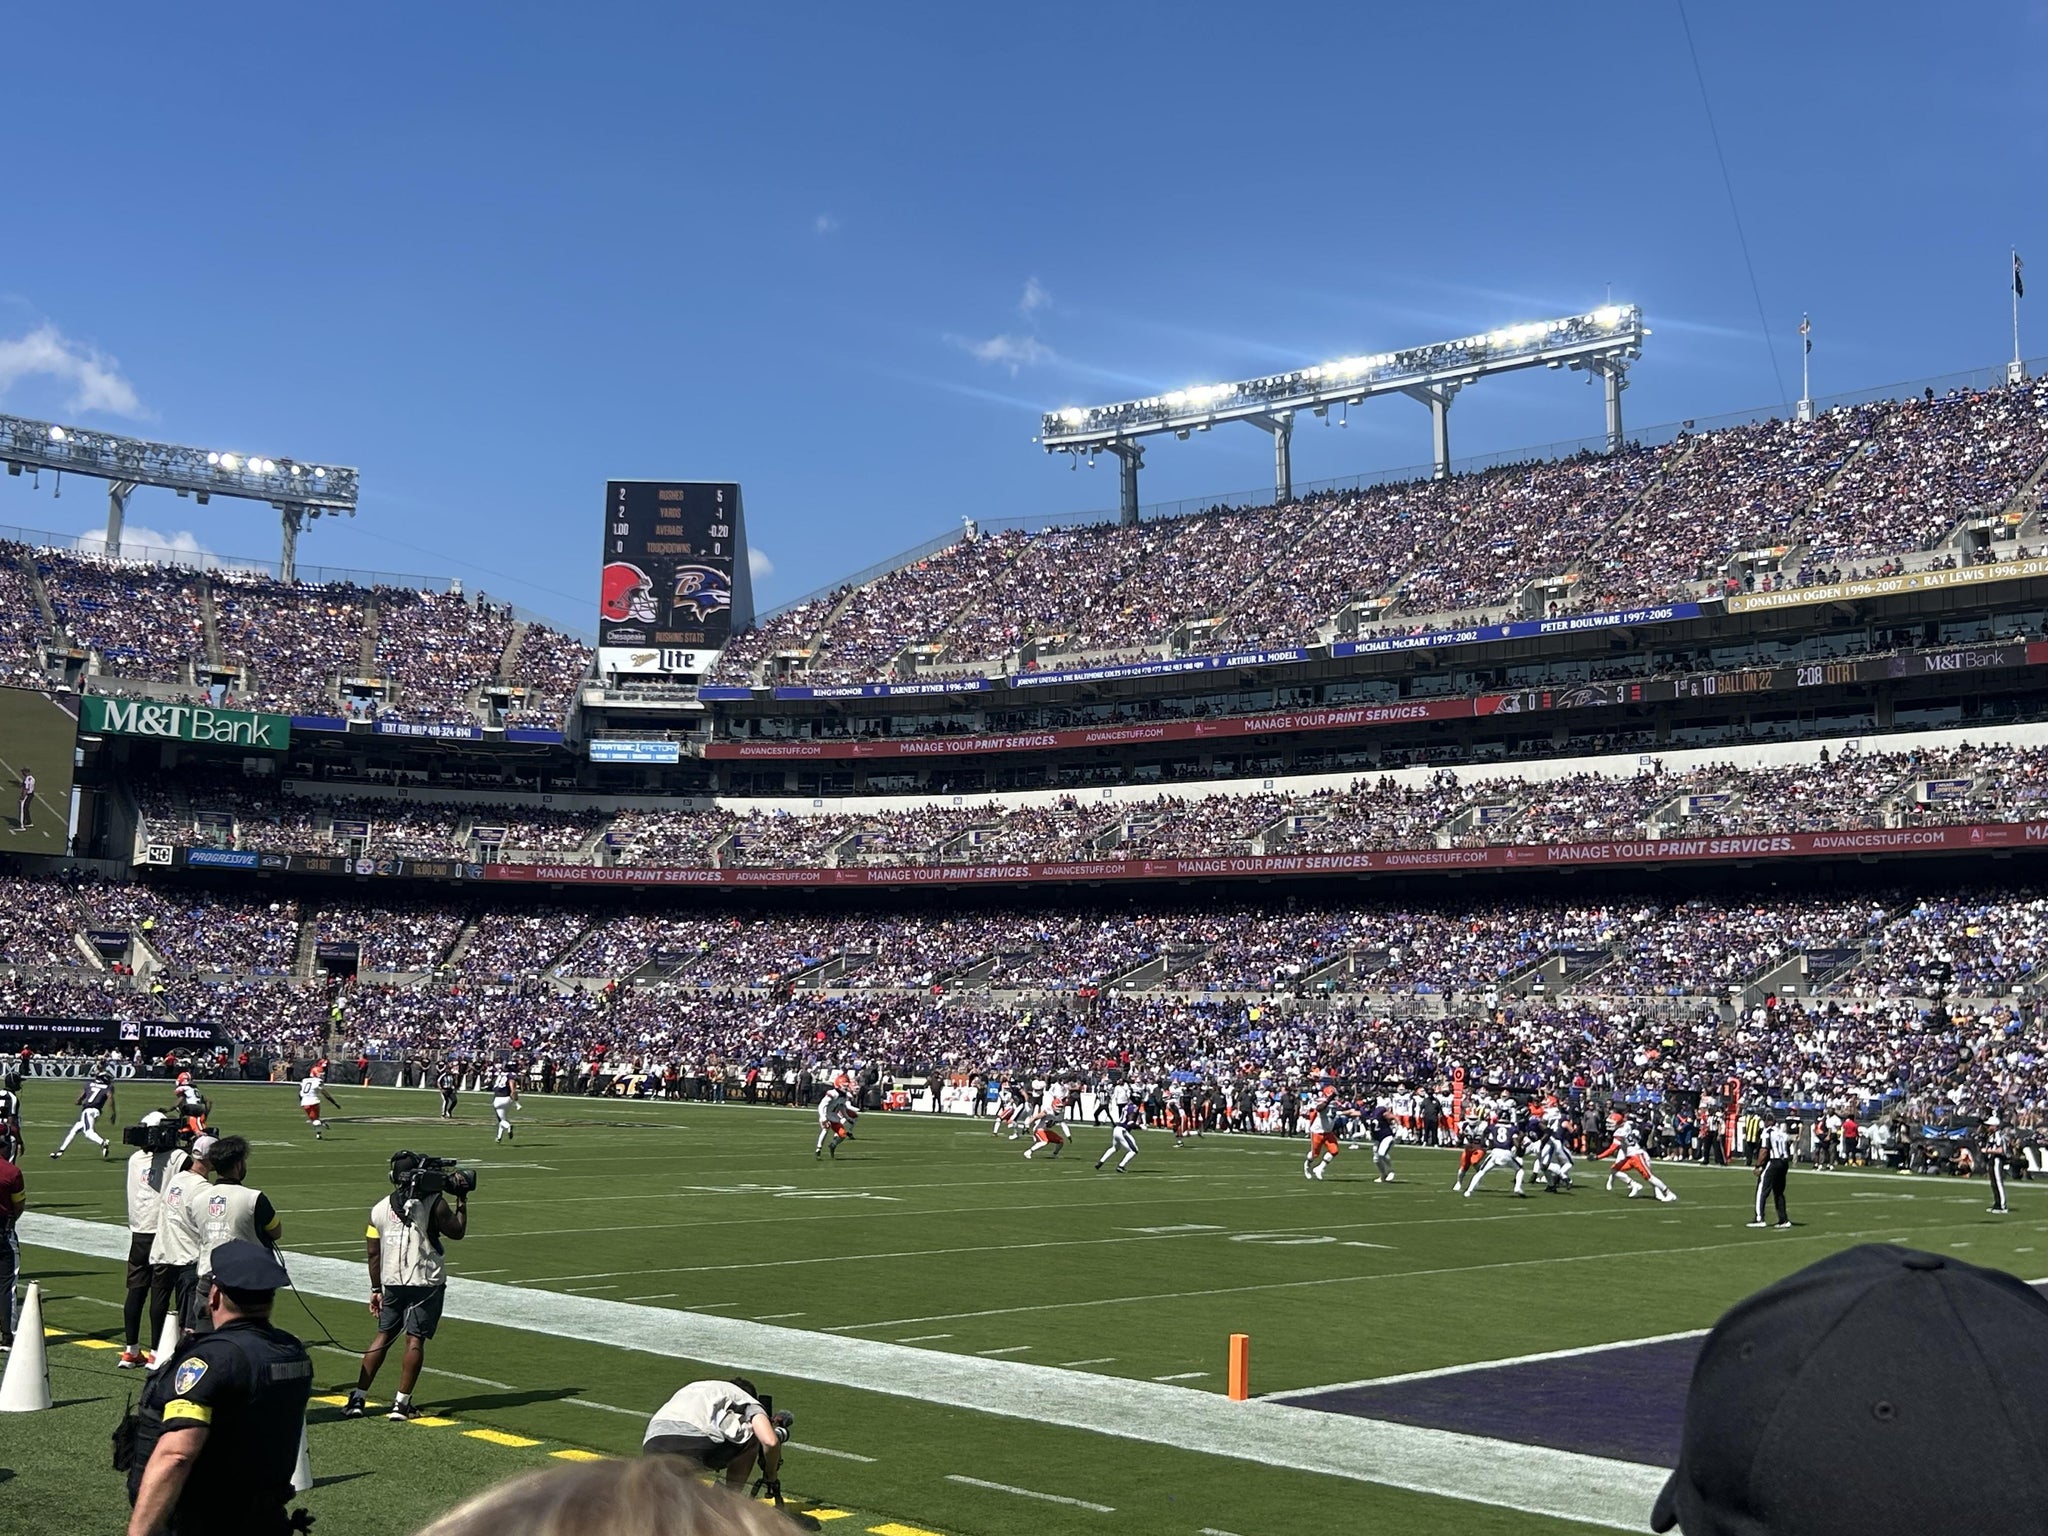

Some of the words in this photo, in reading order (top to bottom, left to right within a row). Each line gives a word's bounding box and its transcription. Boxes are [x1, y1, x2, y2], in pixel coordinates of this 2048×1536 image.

[619, 488, 626, 500] 2
[658, 490, 684, 500] RUSHES
[717, 490, 723, 502] 5
[618, 506, 625, 518] 2
[660, 508, 681, 518] YARDS
[613, 523, 629, 536] 1.00
[655, 525, 684, 536] AVERAGE
[708, 525, 728, 538] -0.20
[617, 541, 623, 553] 0
[647, 543, 691, 554] TOUCHDOWNS
[714, 543, 720, 555] 0
[1923, 574, 1946, 586] RAY
[1949, 569, 1985, 583] LEWIS
[1989, 562, 2048, 578] 1996-2012
[1744, 592, 1801, 611] JONATHAN
[1803, 587, 1841, 602] OGDEN
[1845, 579, 1903, 597] 1996-2007
[1540, 620, 1568, 632] PETER
[1570, 614, 1621, 629] BOULWARE
[1623, 608, 1673, 623] 1997-2005
[655, 632, 683, 643] RUSHING
[685, 633, 704, 643] STATS
[1355, 641, 1390, 653] MICHAEL
[1392, 637, 1430, 649] McCRARY
[1433, 631, 1477, 645] 1997-2002
[658, 649, 695, 672] Lite
[1226, 655, 1257, 666] ARTHUR
[1267, 651, 1298, 662] MODELL
[1925, 652, 1965, 672] M&T
[1966, 650, 2005, 668] Bank
[1017, 677, 1038, 687] JOHNNY
[1039, 675, 1058, 684] UNITAS
[1074, 671, 1104, 680] BALTIMORE
[1105, 669, 1121, 678] COLTS
[1797, 666, 1823, 687] 2:08
[1827, 664, 1850, 684] QTR
[1853, 663, 1858, 681] 1
[890, 686, 919, 695] EARNEST
[921, 684, 945, 693] BYNER
[946, 681, 980, 693] 1996-2003
[1691, 683, 1698, 696] &
[1703, 677, 1715, 695] 10
[1717, 675, 1741, 694] BALL
[1743, 673, 1757, 692] ON
[1759, 671, 1772, 690] 22
[813, 689, 831, 697] RING
[836, 688, 862, 696] HONOR
[1617, 686, 1624, 704] 3
[1528, 694, 1536, 711] 0
[102, 700, 190, 737] M&T
[192, 709, 270, 746] Bank
[1244, 718, 1291, 731] MANAGE
[1294, 716, 1325, 727] YOUR
[1327, 712, 1364, 724] PRINT
[1366, 706, 1429, 721] SERVICES.
[381, 723, 397, 734] TEXT
[397, 723, 411, 735] FOR
[411, 724, 427, 736] HELP
[1085, 729, 1164, 742] ADVANCESTUFF.COM
[900, 742, 943, 753] MANAGE
[946, 741, 973, 752] YOUR
[974, 739, 1004, 750] PRINT
[1005, 735, 1057, 748] SERVICES.
[740, 747, 820, 756] ADVANCESTUFF.COM
[1812, 831, 1944, 848] ADVANCESTUFF.COM
[150, 848, 169, 862] 40
[1548, 845, 1609, 860] MANAGE
[1613, 844, 1655, 857] YOUR
[1658, 841, 1706, 855] PRINT
[1709, 837, 1796, 854] SERVICES.
[190, 851, 257, 865] PROGRESSIVE
[285, 855, 292, 870] 7
[1178, 860, 1227, 872] MANAGE
[1230, 859, 1262, 871] YOUR
[1264, 857, 1304, 869] PRINT
[1305, 855, 1372, 869] SERVICES.
[1385, 852, 1488, 865] ADVANCESTUFF.COM
[344, 859, 352, 874] 6
[432, 865, 447, 876] 2ND
[455, 864, 463, 878] 0
[1042, 864, 1126, 876] ADVANCESTUFF.COM
[536, 868, 587, 879] MANAGE
[590, 870, 624, 880] YOUR
[625, 870, 662, 881] PRINT
[664, 871, 725, 881] SERVICES.
[736, 872, 820, 881] ADVANCESTUFF.COM
[868, 869, 911, 881] MANAGE
[912, 868, 941, 880] YOUR
[942, 867, 975, 879] PRINT
[976, 867, 1032, 878] SERVICES.
[88, 1087, 101, 1103] 7
[303, 1082, 312, 1094] 0
[1497, 1129, 1507, 1143] 8
[209, 1203, 224, 1215] NFL
